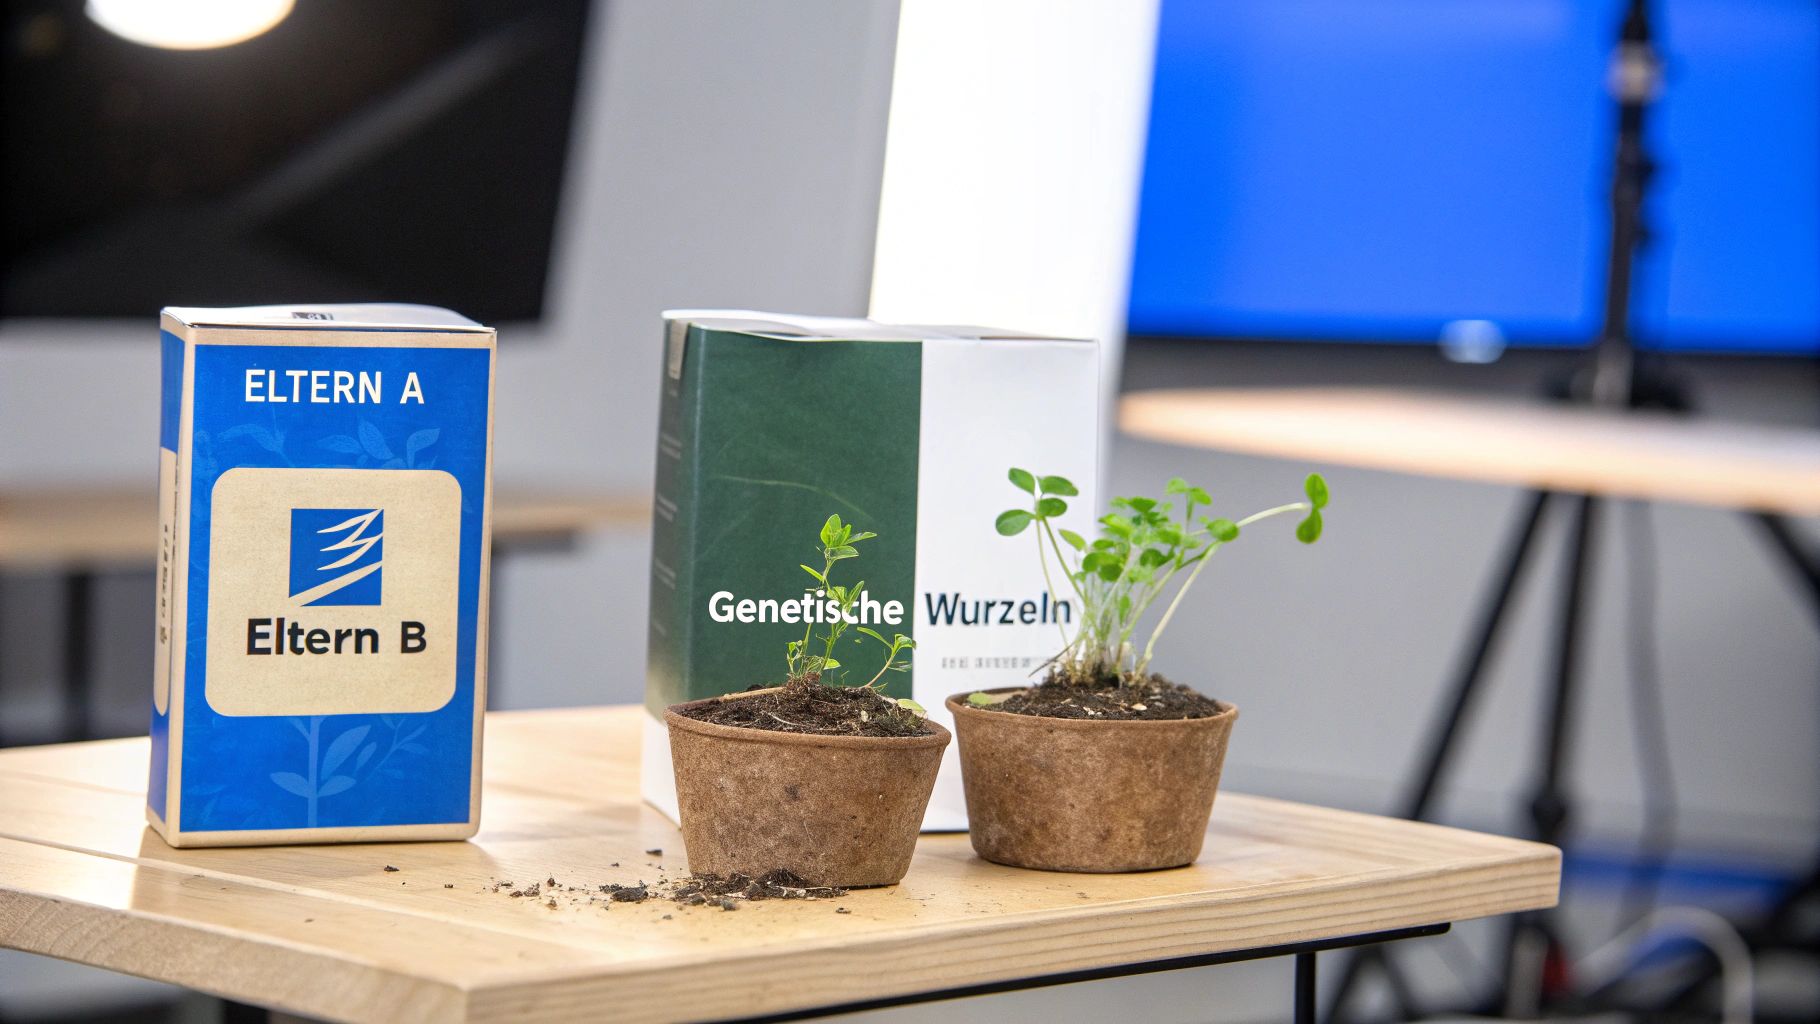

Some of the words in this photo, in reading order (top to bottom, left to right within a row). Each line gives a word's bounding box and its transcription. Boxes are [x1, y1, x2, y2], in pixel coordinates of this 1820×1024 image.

[244, 369, 382, 404] ELTERN
[399, 371, 425, 405] A
[708, 589, 905, 625] Genetische
[924, 591, 1072, 626] Wurzeln
[246, 617, 379, 656] Eltern
[400, 621, 427, 654] B
